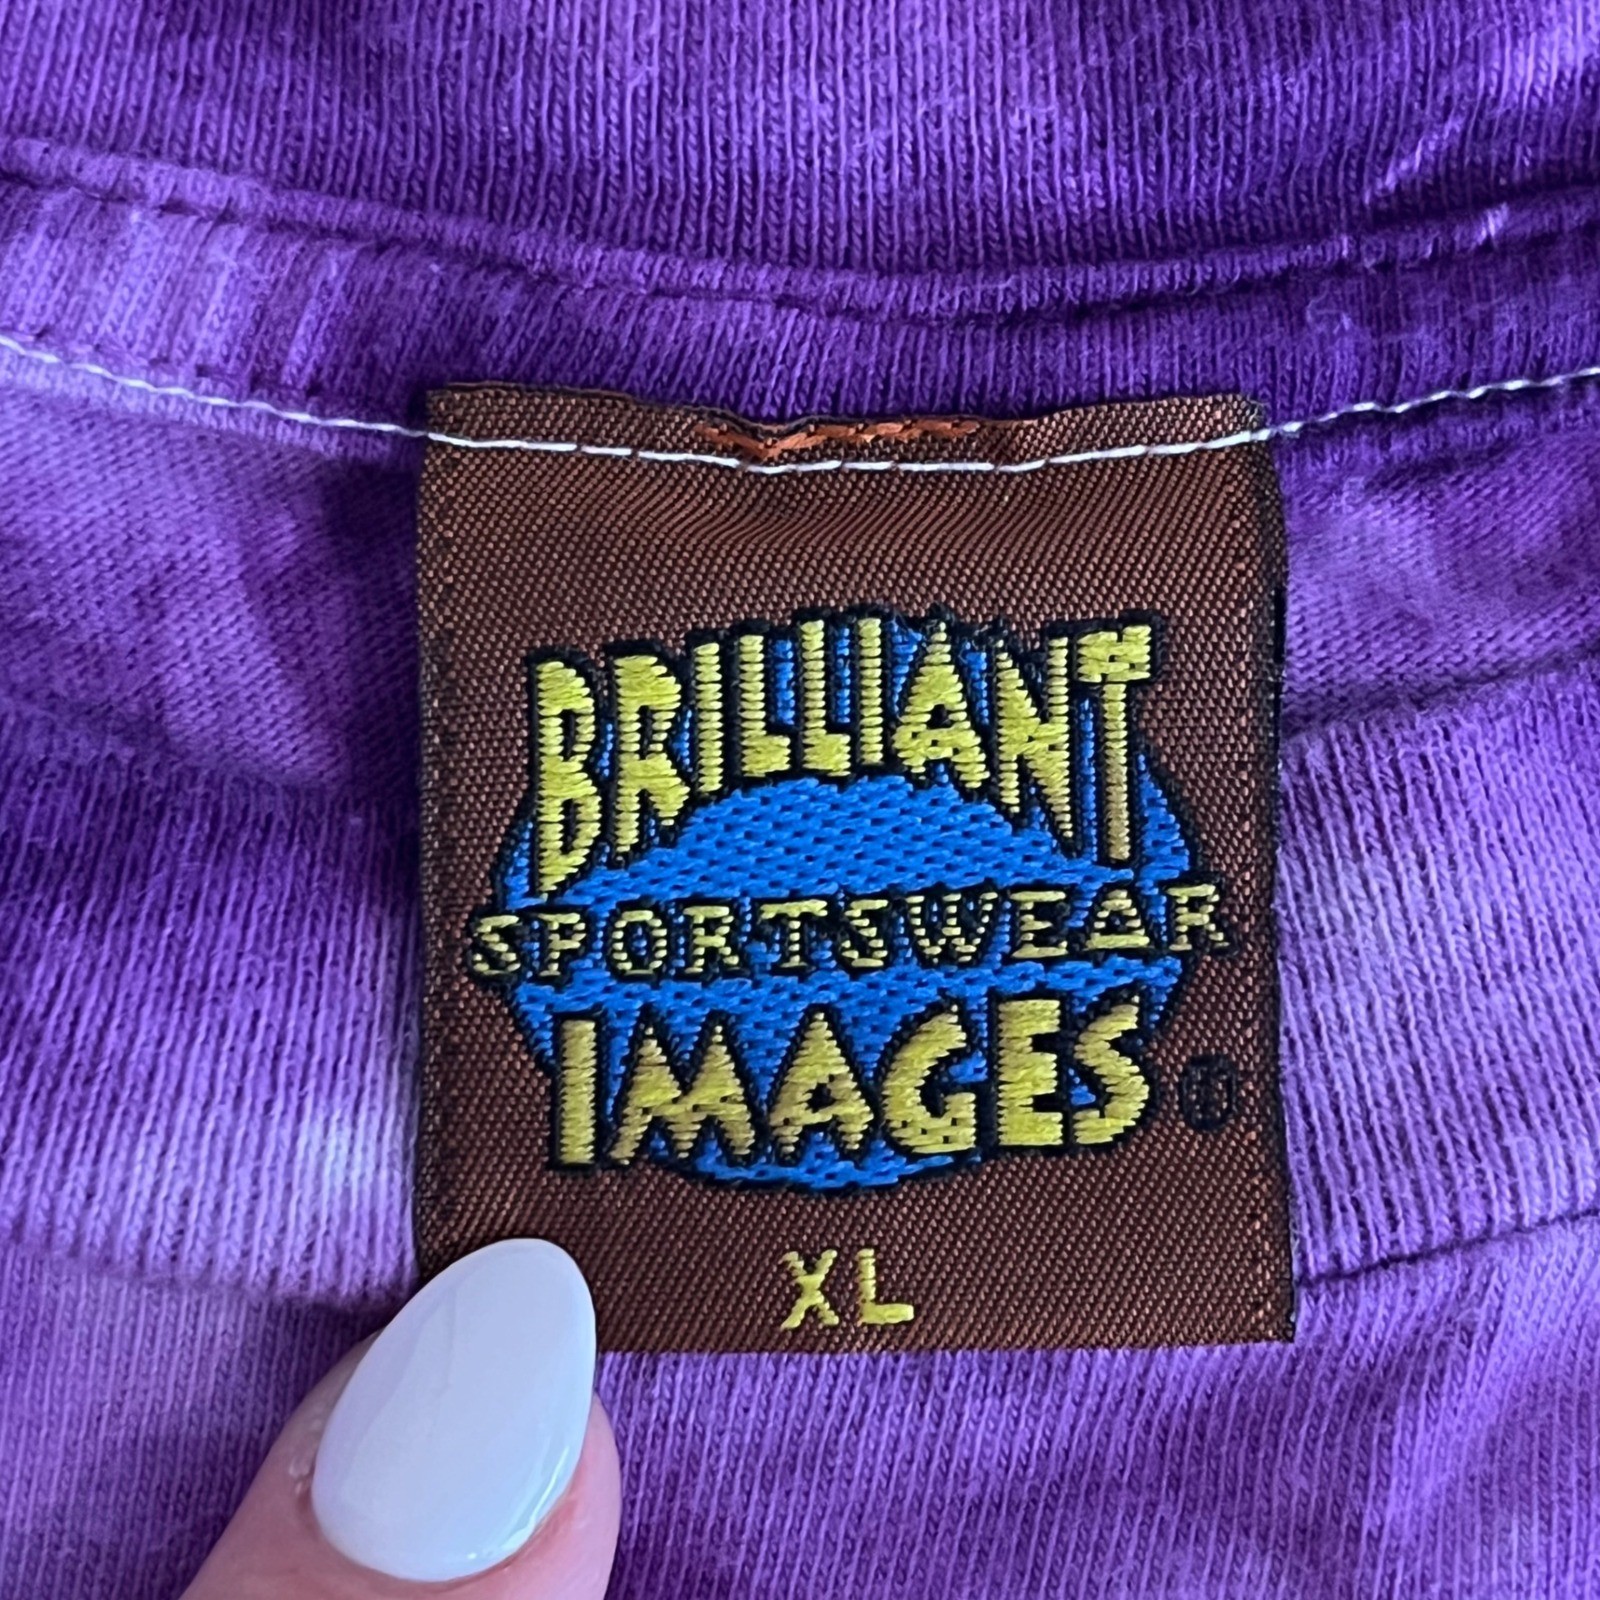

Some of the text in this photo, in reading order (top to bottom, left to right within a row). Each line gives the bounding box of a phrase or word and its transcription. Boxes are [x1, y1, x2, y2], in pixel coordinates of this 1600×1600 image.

[534, 617, 1153, 894] BRILLIANT
[473, 882, 1227, 978] SPORTSWEAR
[555, 995, 1150, 1167] IMAGES
[779, 1247, 915, 1333] XL
